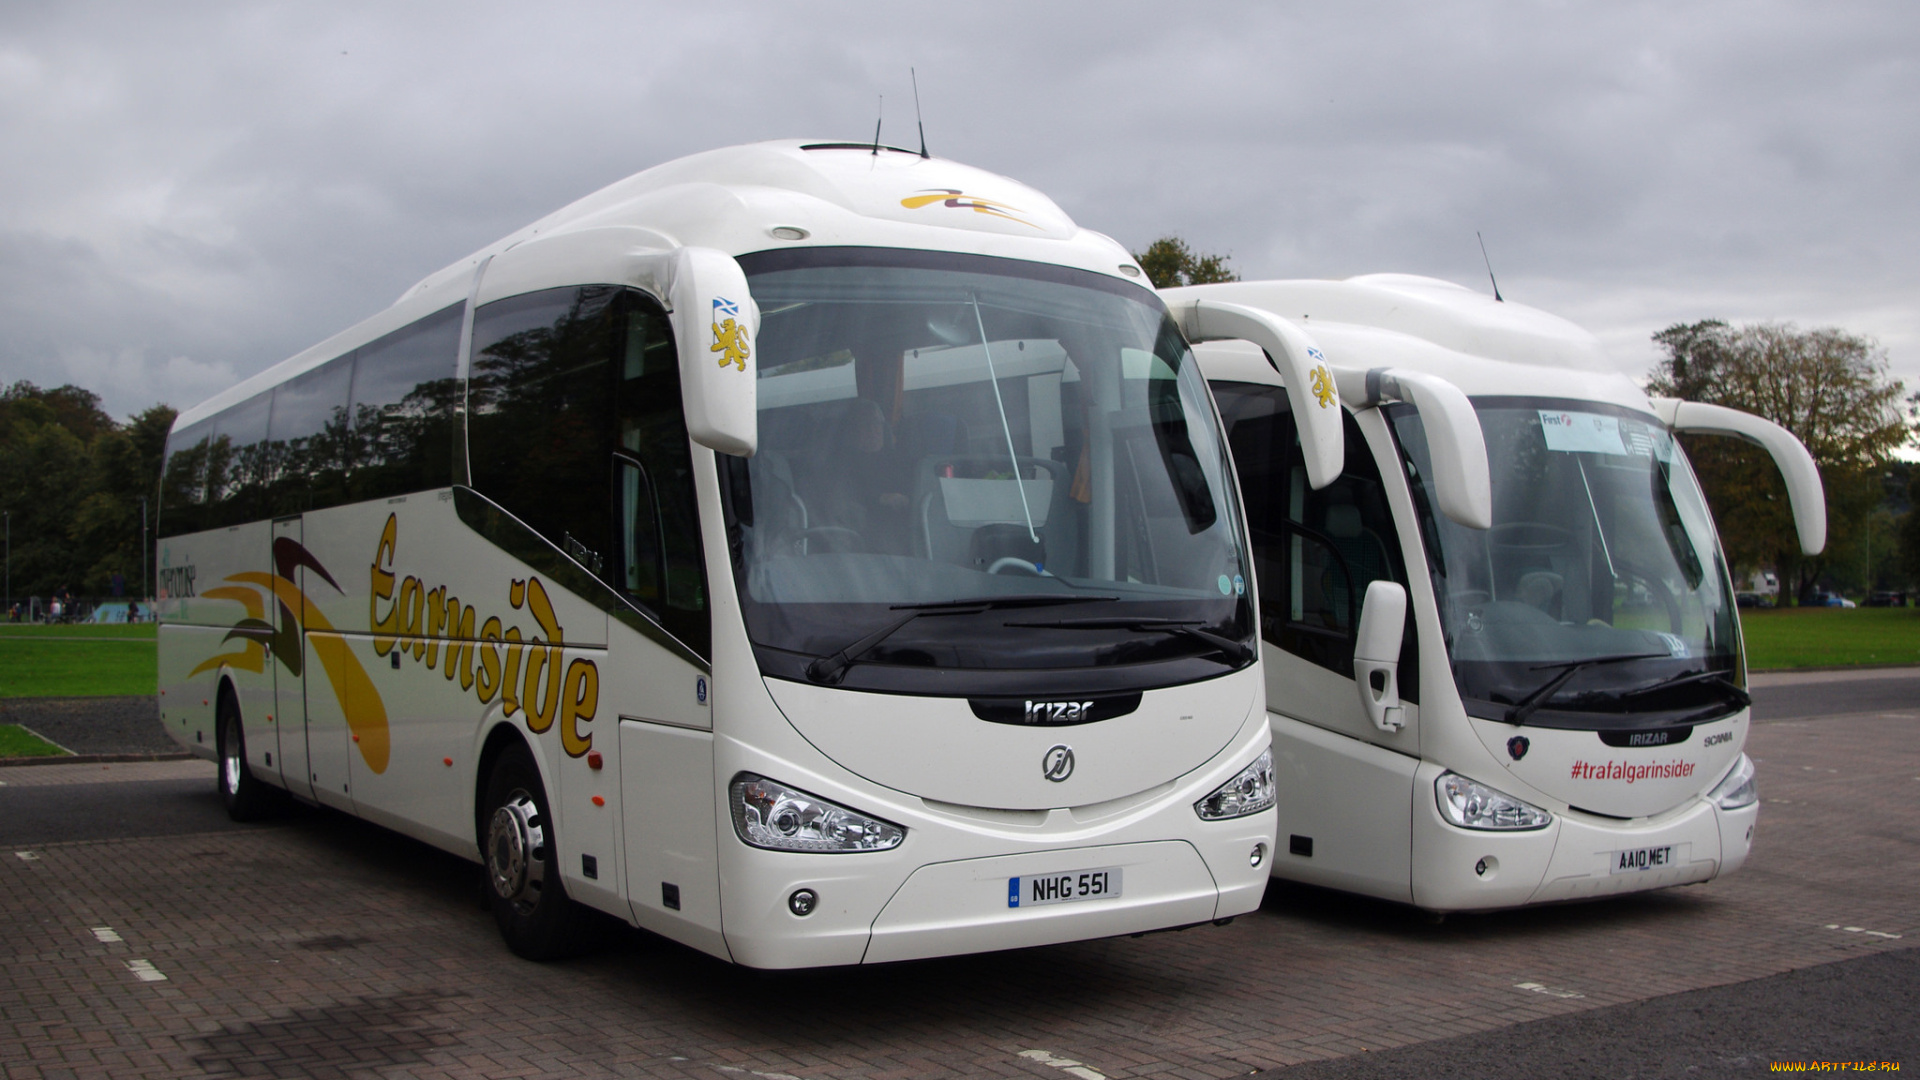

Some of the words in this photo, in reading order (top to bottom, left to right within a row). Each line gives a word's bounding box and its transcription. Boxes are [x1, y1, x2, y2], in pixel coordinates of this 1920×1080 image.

[1542, 414, 1562, 426] First
[371, 512, 599, 758] Earnside
[1024, 700, 1094, 723] Irizar
[1629, 732, 1669, 746] IRIZAR
[1703, 731, 1733, 748] SCANIA
[1570, 759, 1696, 783] #trafalgarinsider
[1618, 848, 1646, 870] AA10
[1648, 847, 1671, 866] MET
[1033, 876, 1072, 902] NHG
[1078, 872, 1108, 897] 551
